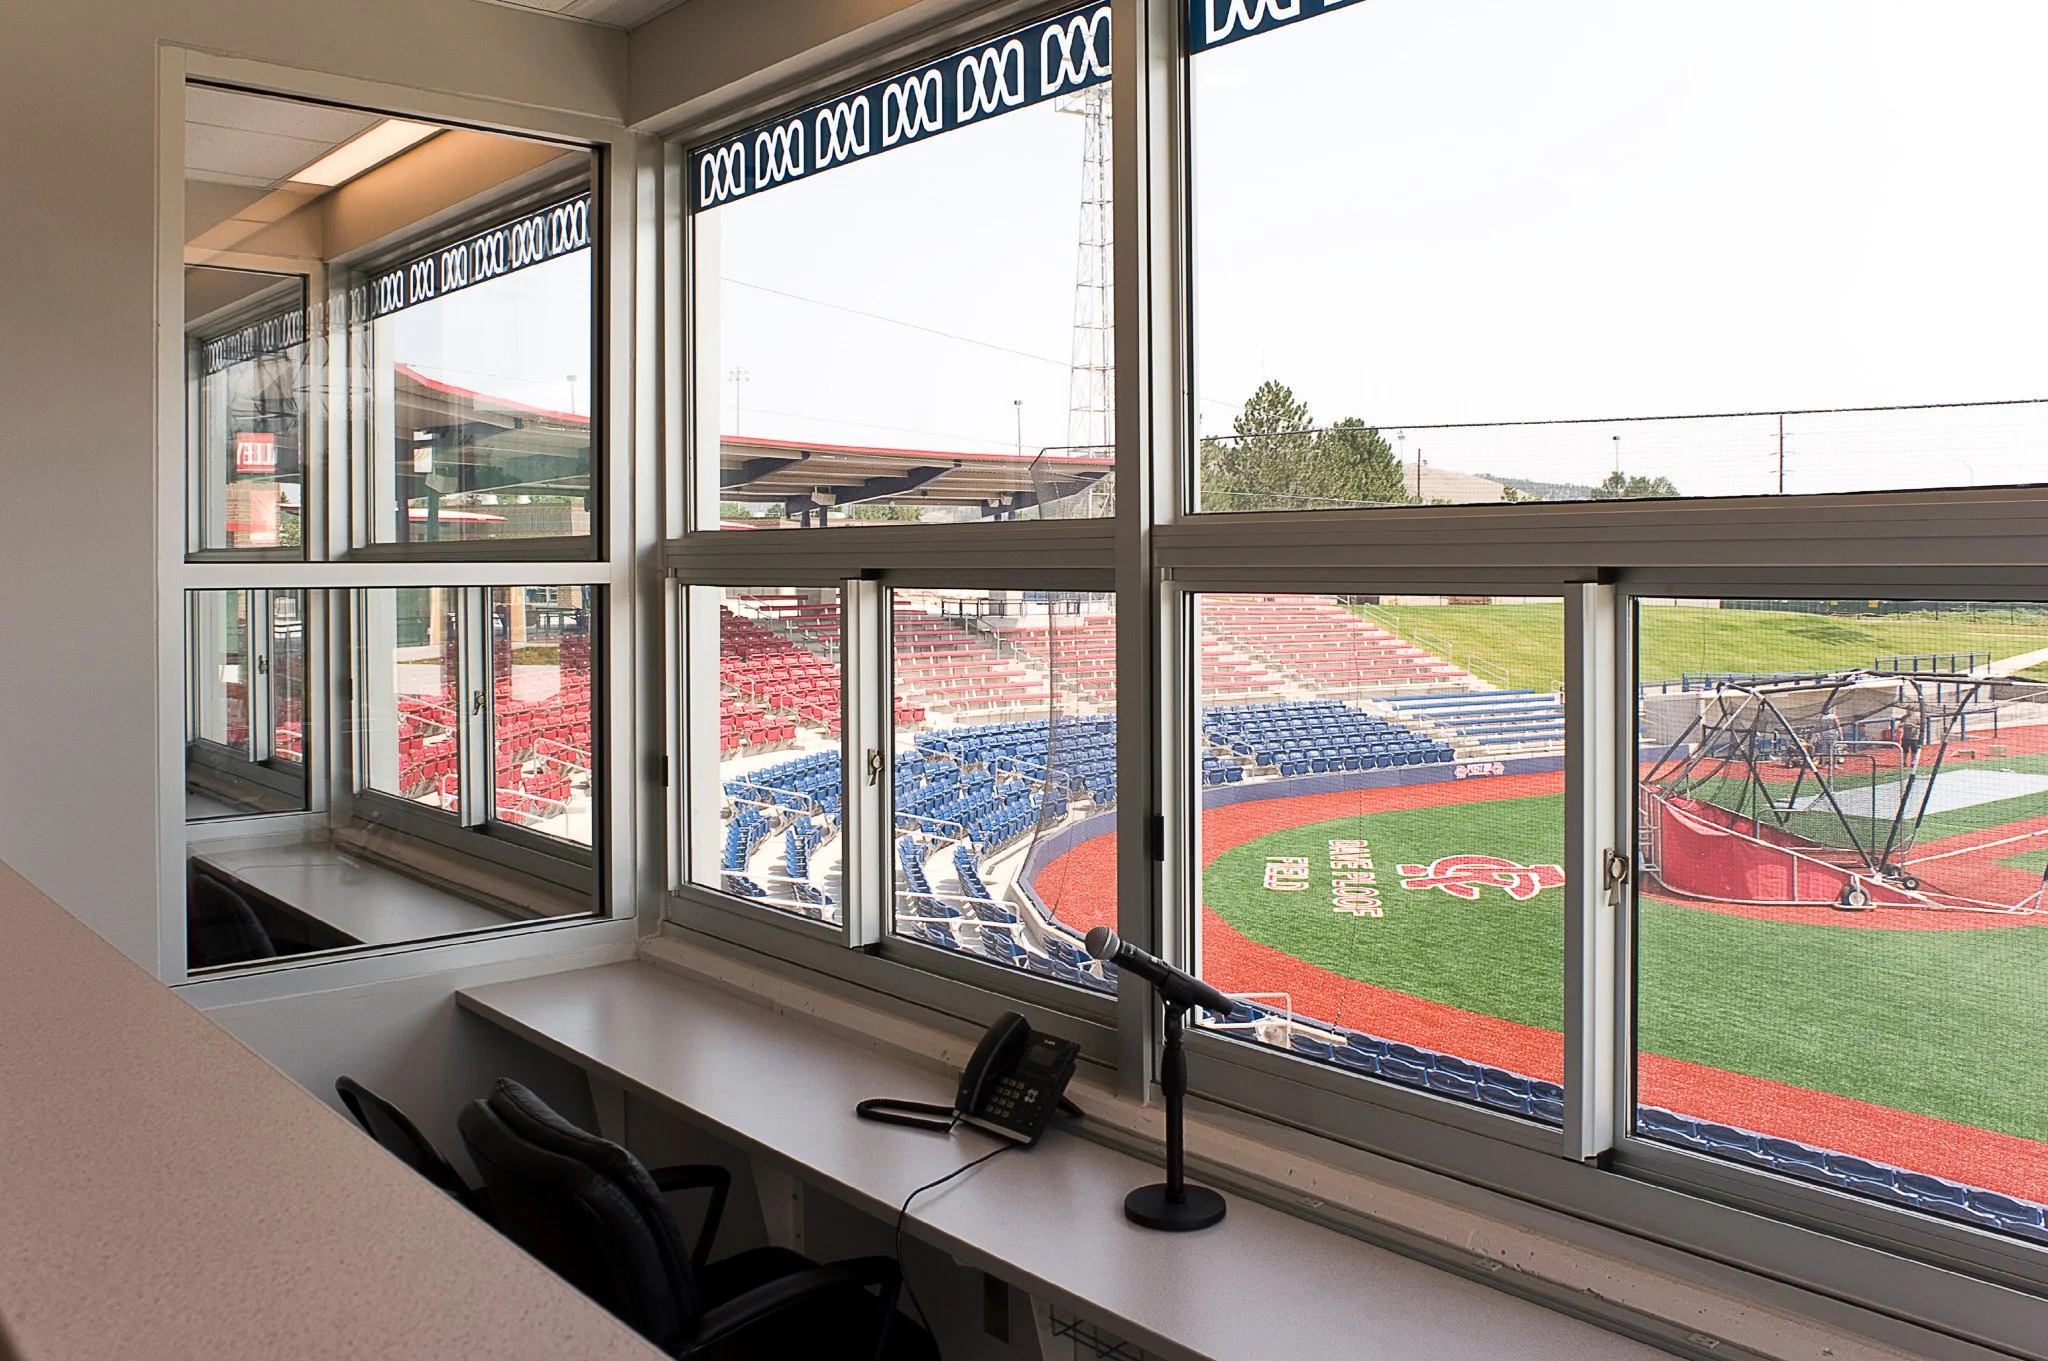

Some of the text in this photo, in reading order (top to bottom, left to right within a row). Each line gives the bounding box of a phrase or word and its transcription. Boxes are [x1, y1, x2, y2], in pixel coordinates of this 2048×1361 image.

[1263, 857, 1309, 892] FIELD
[1329, 839, 1383, 918] DAVE PLOOF
